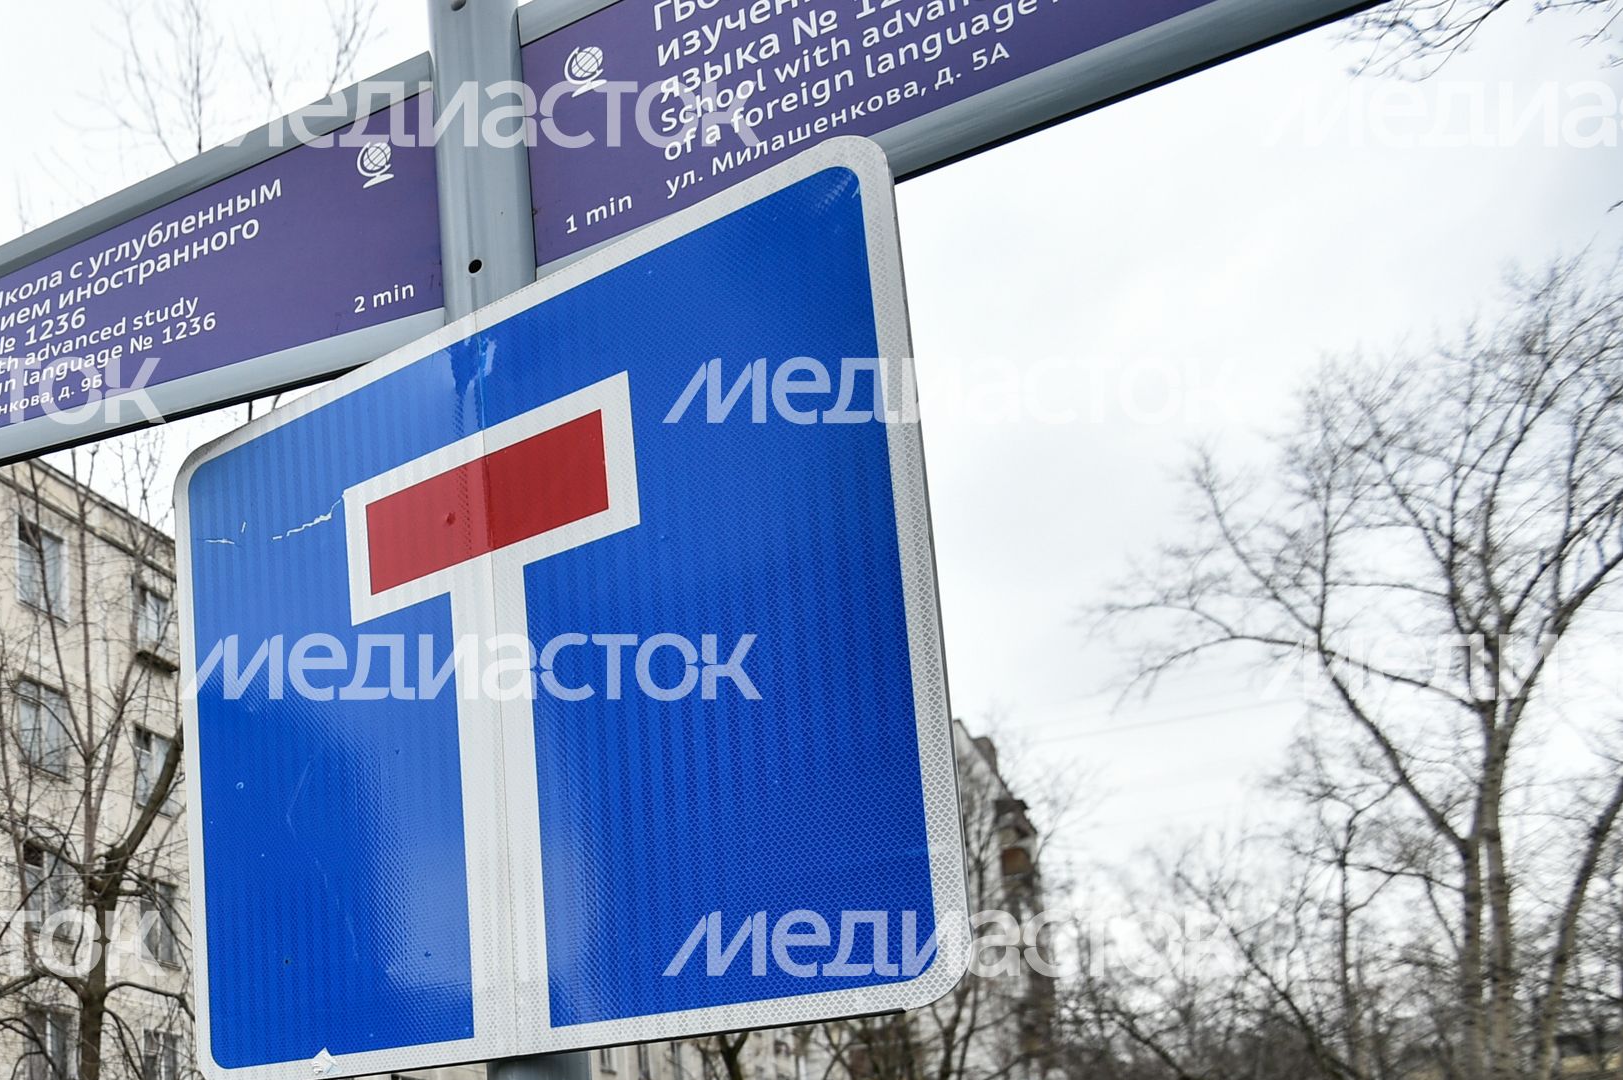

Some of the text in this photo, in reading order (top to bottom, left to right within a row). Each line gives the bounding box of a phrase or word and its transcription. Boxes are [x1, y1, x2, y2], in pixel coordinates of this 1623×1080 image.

[657, 0, 810, 67] изучен
[660, 33, 781, 103] языка
[792, 9, 838, 46] №
[661, 0, 969, 133] School with advan
[664, 0, 1038, 161] of a foreign language
[665, 42, 1010, 199] ул. Милашенкова, д. 5А
[69, 261, 83, 279] с
[87, 178, 283, 279] углубленным
[565, 195, 633, 234] 1 min
[58, 219, 260, 310] иностранного
[354, 281, 415, 314] 2 min
[23, 345, 123, 386] language
[130, 329, 154, 352] №
[162, 311, 217, 346] 1236
[24, 307, 87, 346] 1236
[24, 316, 127, 367] advanced
[132, 296, 199, 330] study
[57, 384, 76, 401] д.
[81, 374, 103, 392] 9Б
